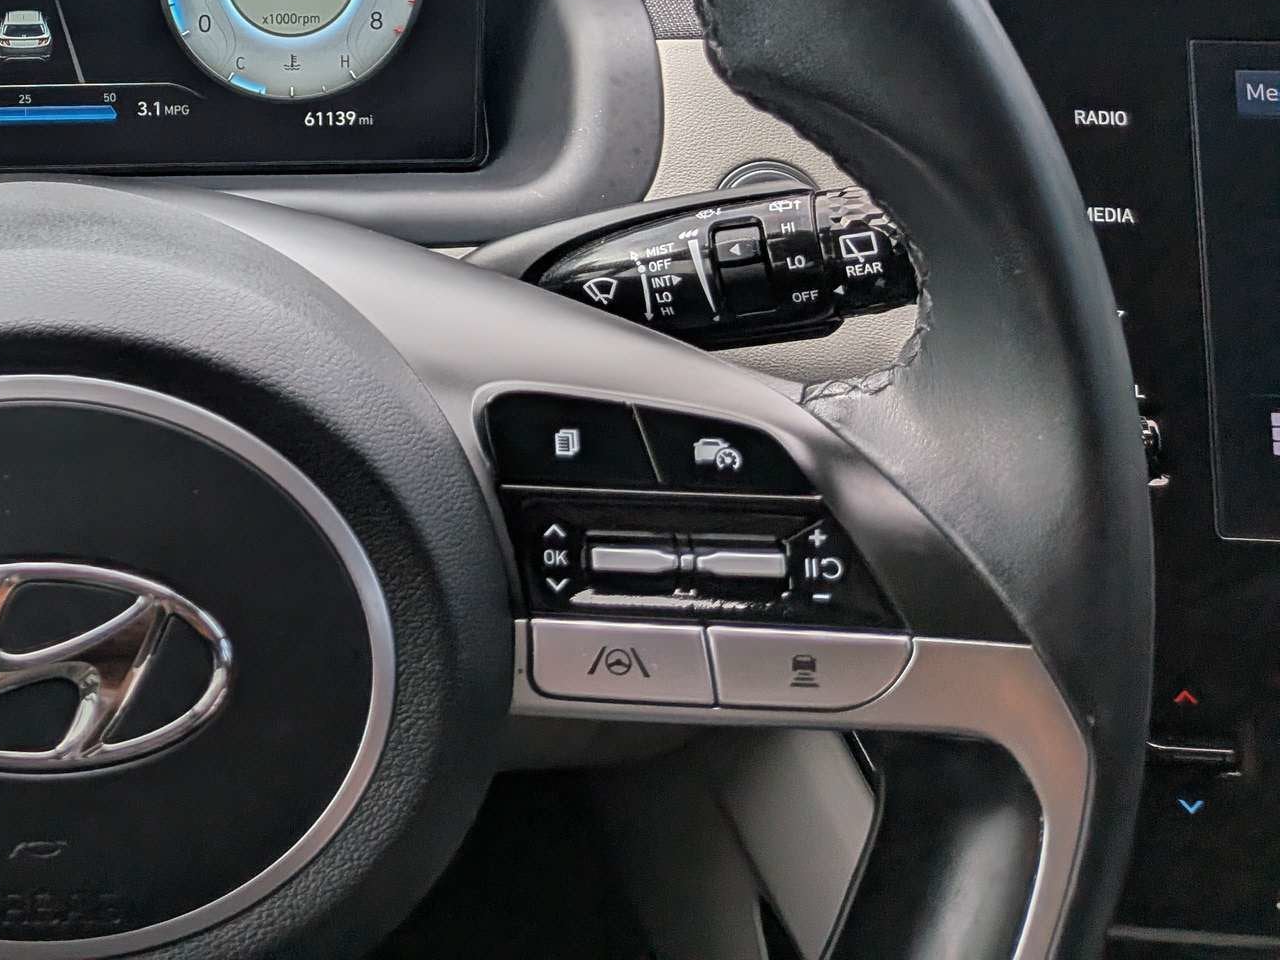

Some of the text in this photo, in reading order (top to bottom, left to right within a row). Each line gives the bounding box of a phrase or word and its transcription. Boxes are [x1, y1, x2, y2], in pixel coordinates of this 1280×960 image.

[198, 14, 211, 32] 0
[262, 12, 321, 27] x1000rpm
[370, 13, 383, 30] 8
[236, 57, 245, 70] C
[340, 55, 350, 68] H
[18, 94, 31, 105] 25
[103, 93, 116, 103] 50
[137, 101, 189, 117] 3.1 MPG
[304, 112, 356, 127] 61139
[1074, 109, 1128, 127] RADIO
[781, 222, 796, 234] HI
[646, 242, 675, 258] MIST
[648, 259, 672, 273] OFF
[787, 256, 806, 270] LO
[846, 261, 883, 277] REAR
[652, 275, 672, 288] INT
[656, 292, 672, 303] LO
[792, 290, 819, 303] OFF
[660, 306, 674, 316] HI
[543, 549, 567, 566] OK
